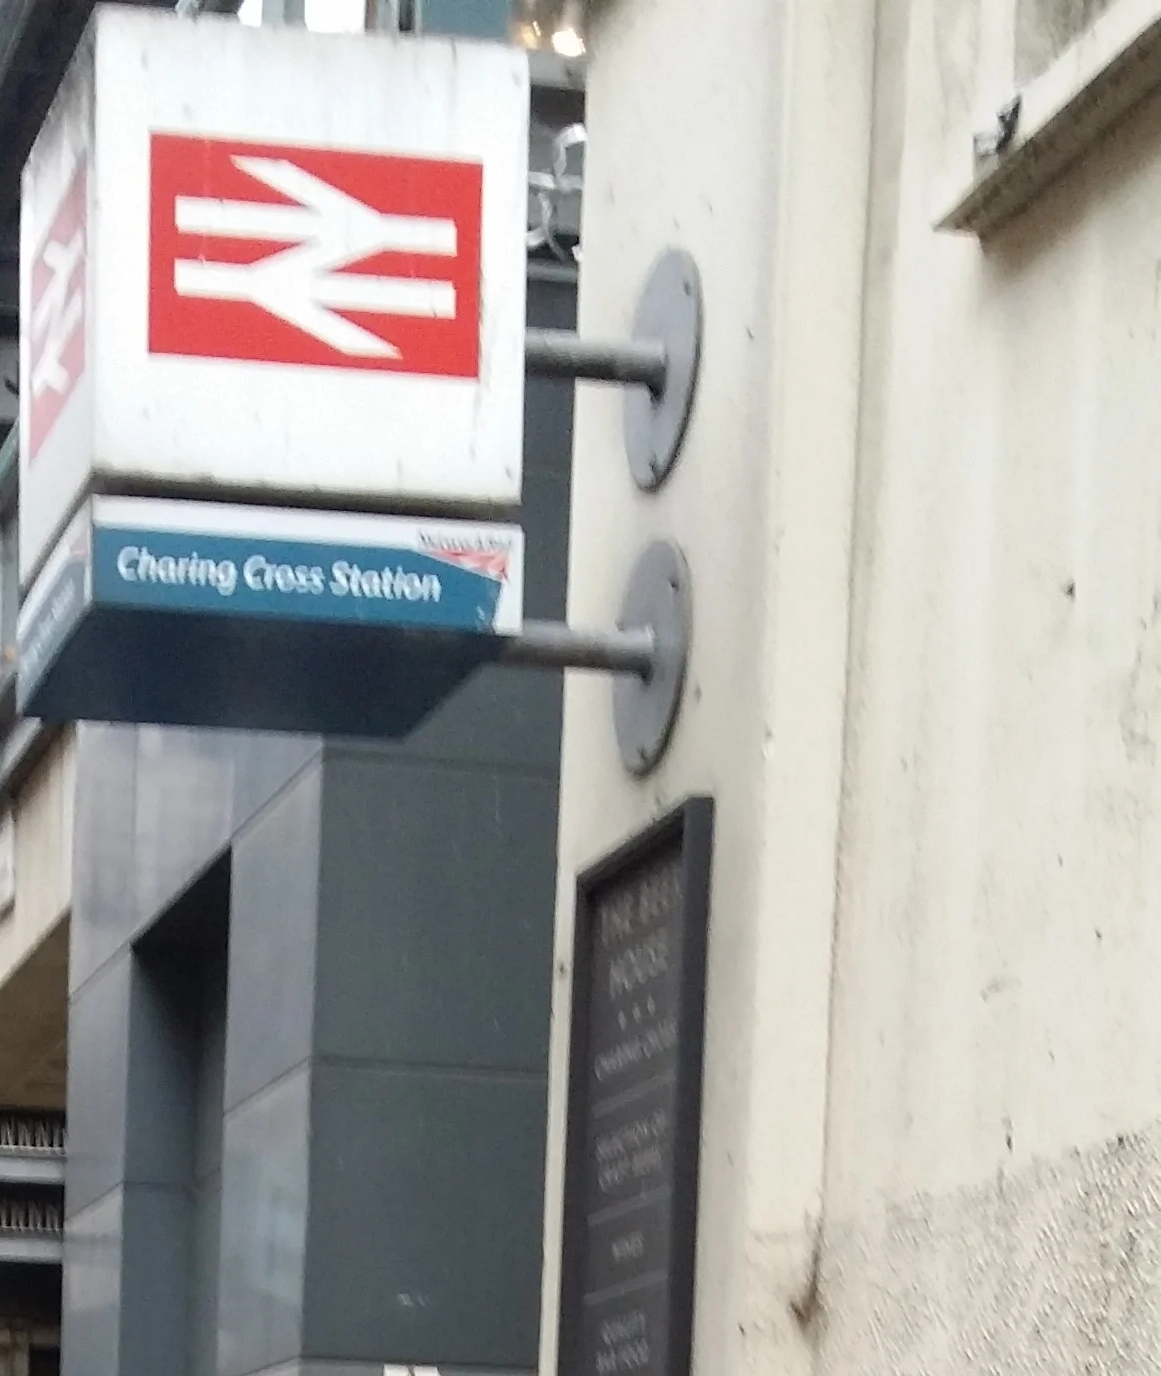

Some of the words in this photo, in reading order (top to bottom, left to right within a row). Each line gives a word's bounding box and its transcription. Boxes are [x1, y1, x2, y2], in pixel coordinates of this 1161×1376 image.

[117, 545, 237, 595] Charing
[243, 555, 325, 594] Cross
[329, 560, 442, 603] Station
